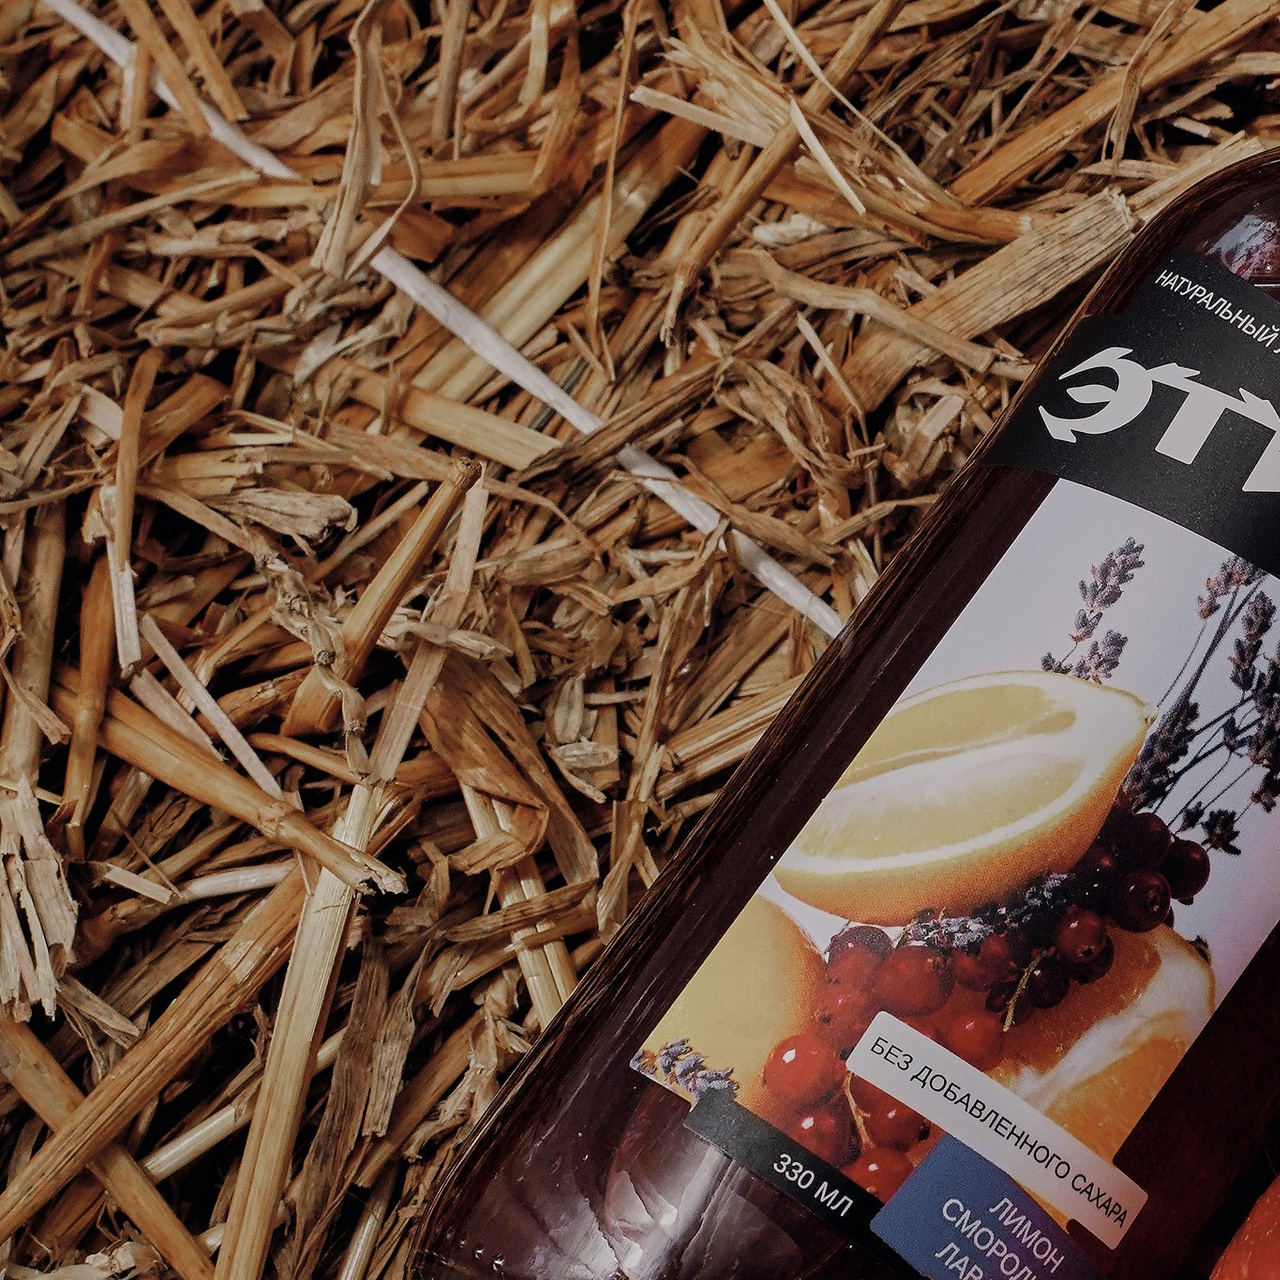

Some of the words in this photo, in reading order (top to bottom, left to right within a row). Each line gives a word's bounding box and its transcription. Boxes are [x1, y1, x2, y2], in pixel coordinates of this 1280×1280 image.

[1154, 269, 1279, 348] НАТУРАЛЬНЫЙ
[870, 1036, 914, 1072] БЕЗ
[909, 1064, 1072, 1181] ДОБАВЛЕННОГО
[1071, 1173, 1130, 1229] САХАРА
[773, 1153, 815, 1190] 330
[813, 1177, 854, 1218] МЛ
[988, 1196, 1065, 1273] ЛИМОН
